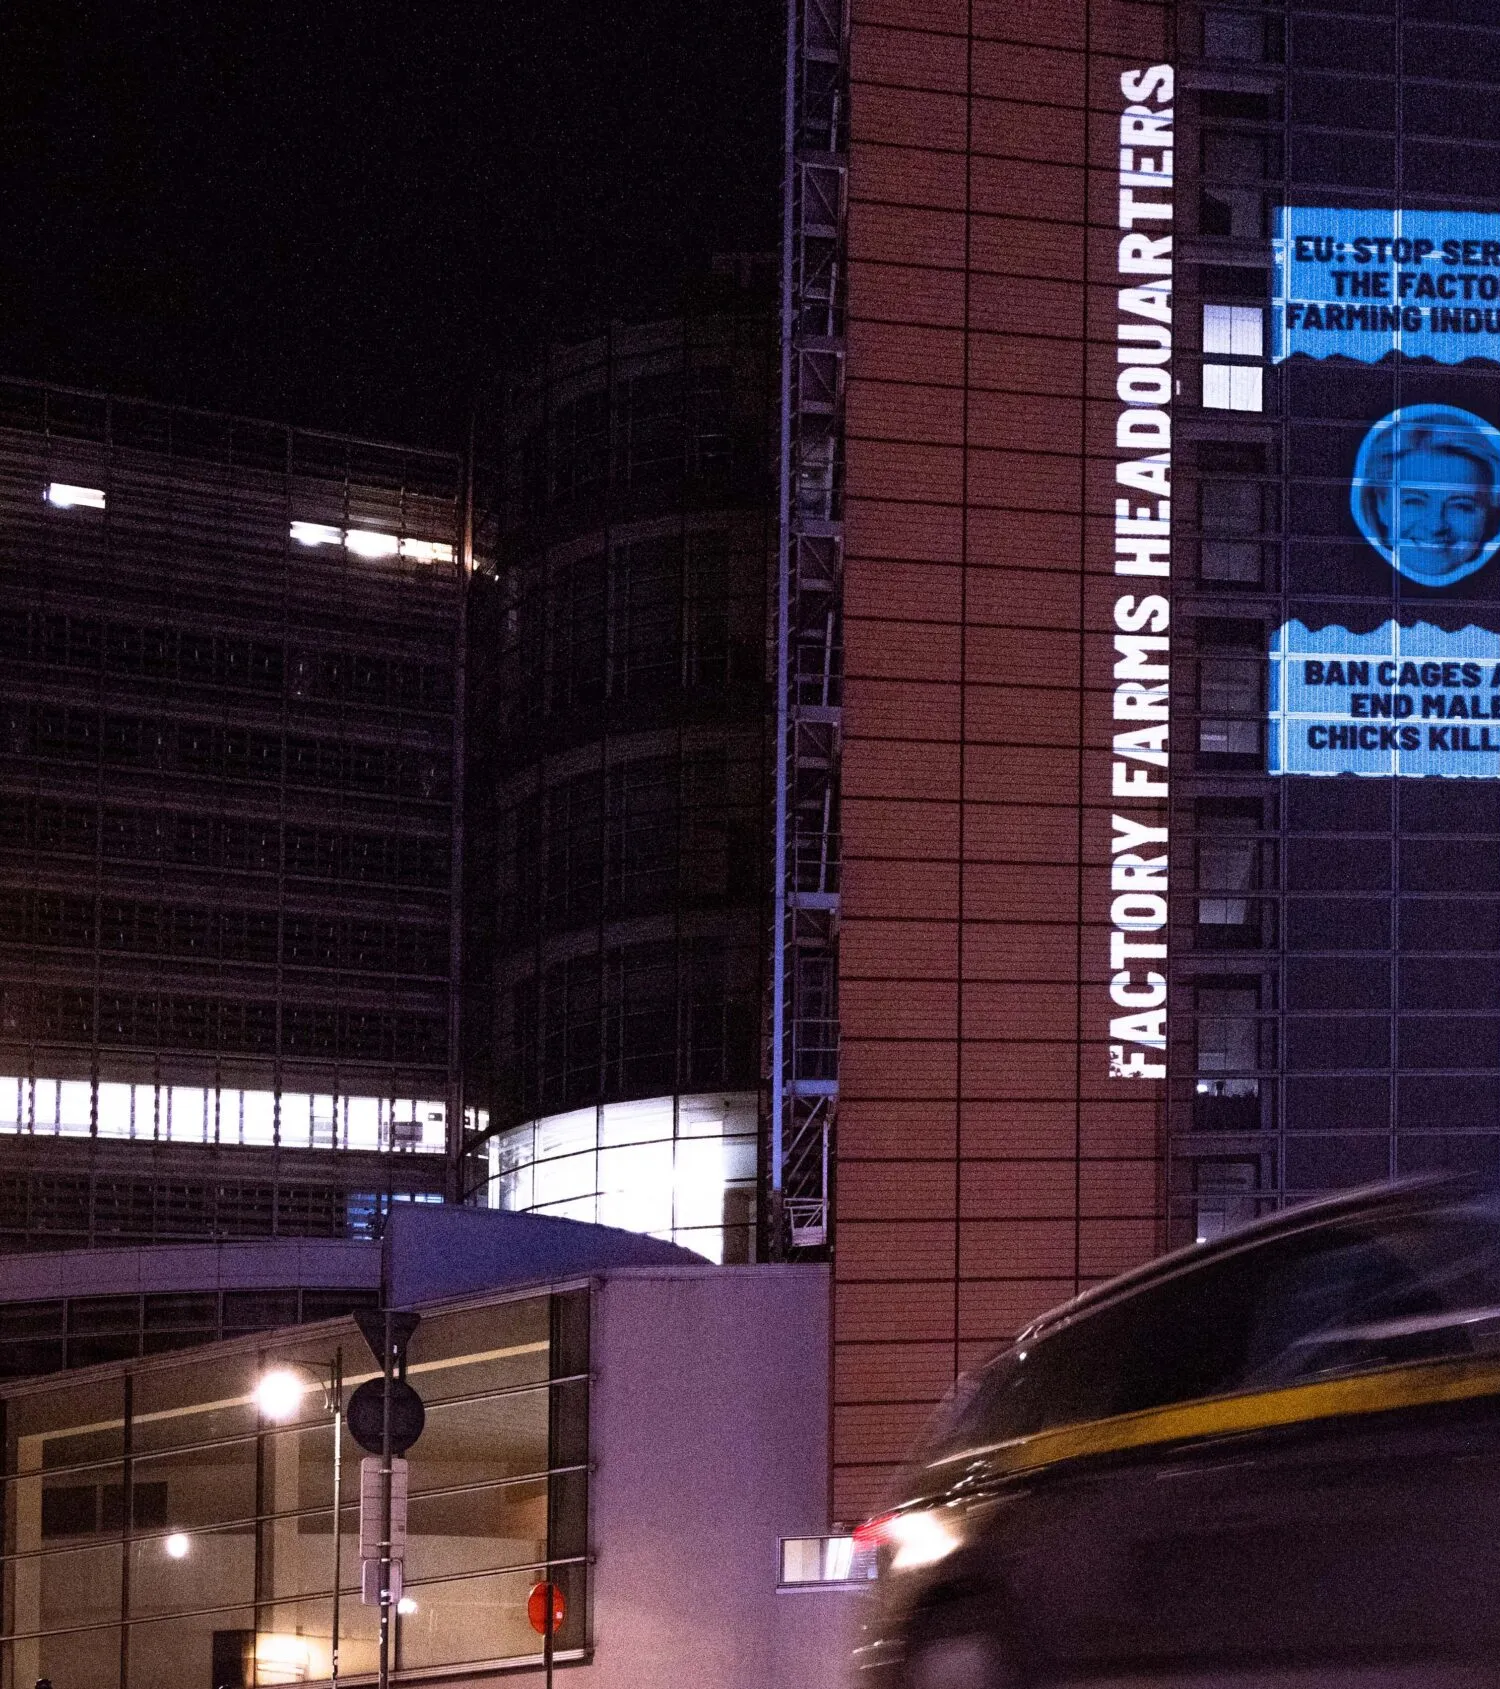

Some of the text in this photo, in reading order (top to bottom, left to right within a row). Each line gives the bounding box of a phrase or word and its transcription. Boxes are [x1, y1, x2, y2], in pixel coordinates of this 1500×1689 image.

[1295, 236, 1345, 263] EU:
[1353, 237, 1434, 265] STOP
[1331, 271, 1389, 298] THE
[1286, 304, 1421, 333] FARMING
[1109, 64, 1181, 1079] FACTORY FARMS HEADQUARTERS
[1305, 660, 1369, 686] BAN
[1378, 662, 1481, 688] CAGES
[1351, 693, 1413, 718] END
[1308, 725, 1420, 751] CHICKS
